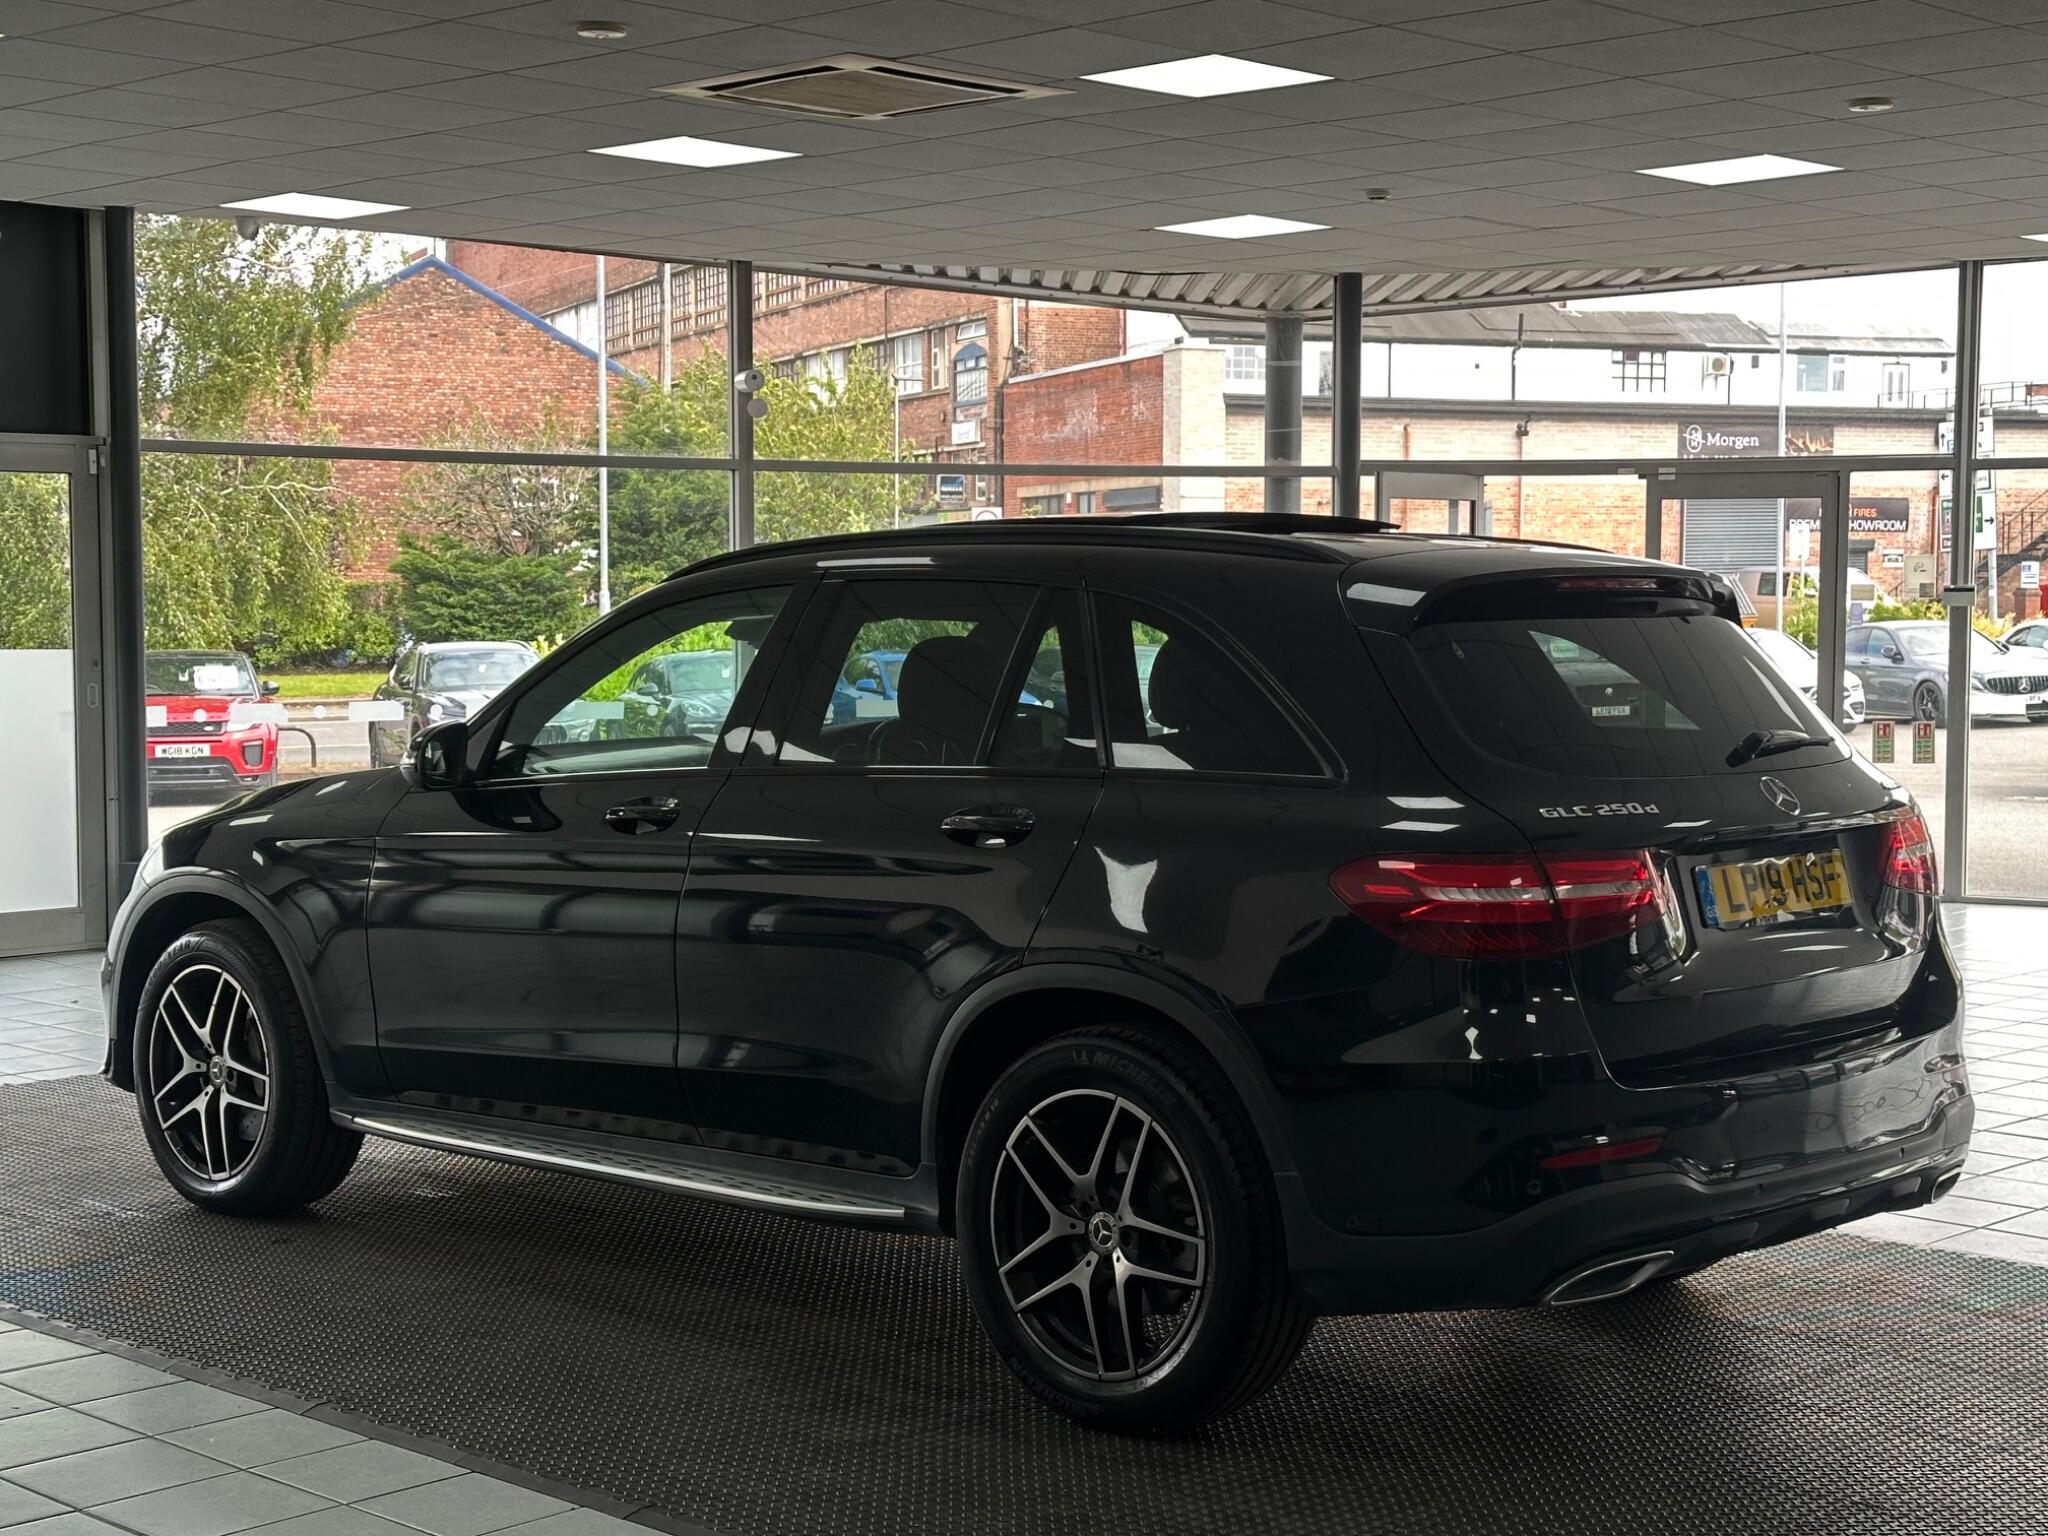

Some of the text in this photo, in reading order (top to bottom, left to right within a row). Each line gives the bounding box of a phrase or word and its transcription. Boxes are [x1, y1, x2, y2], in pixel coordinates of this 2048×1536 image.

[1706, 432, 1760, 450] Morgen
[1853, 508, 1878, 518] FIRES
[1848, 520, 1907, 531] HOWROOM
[185, 746, 204, 755] KGN
[1538, 802, 1661, 819] GLC 250d
[1721, 853, 1838, 913] LP19 HSF
